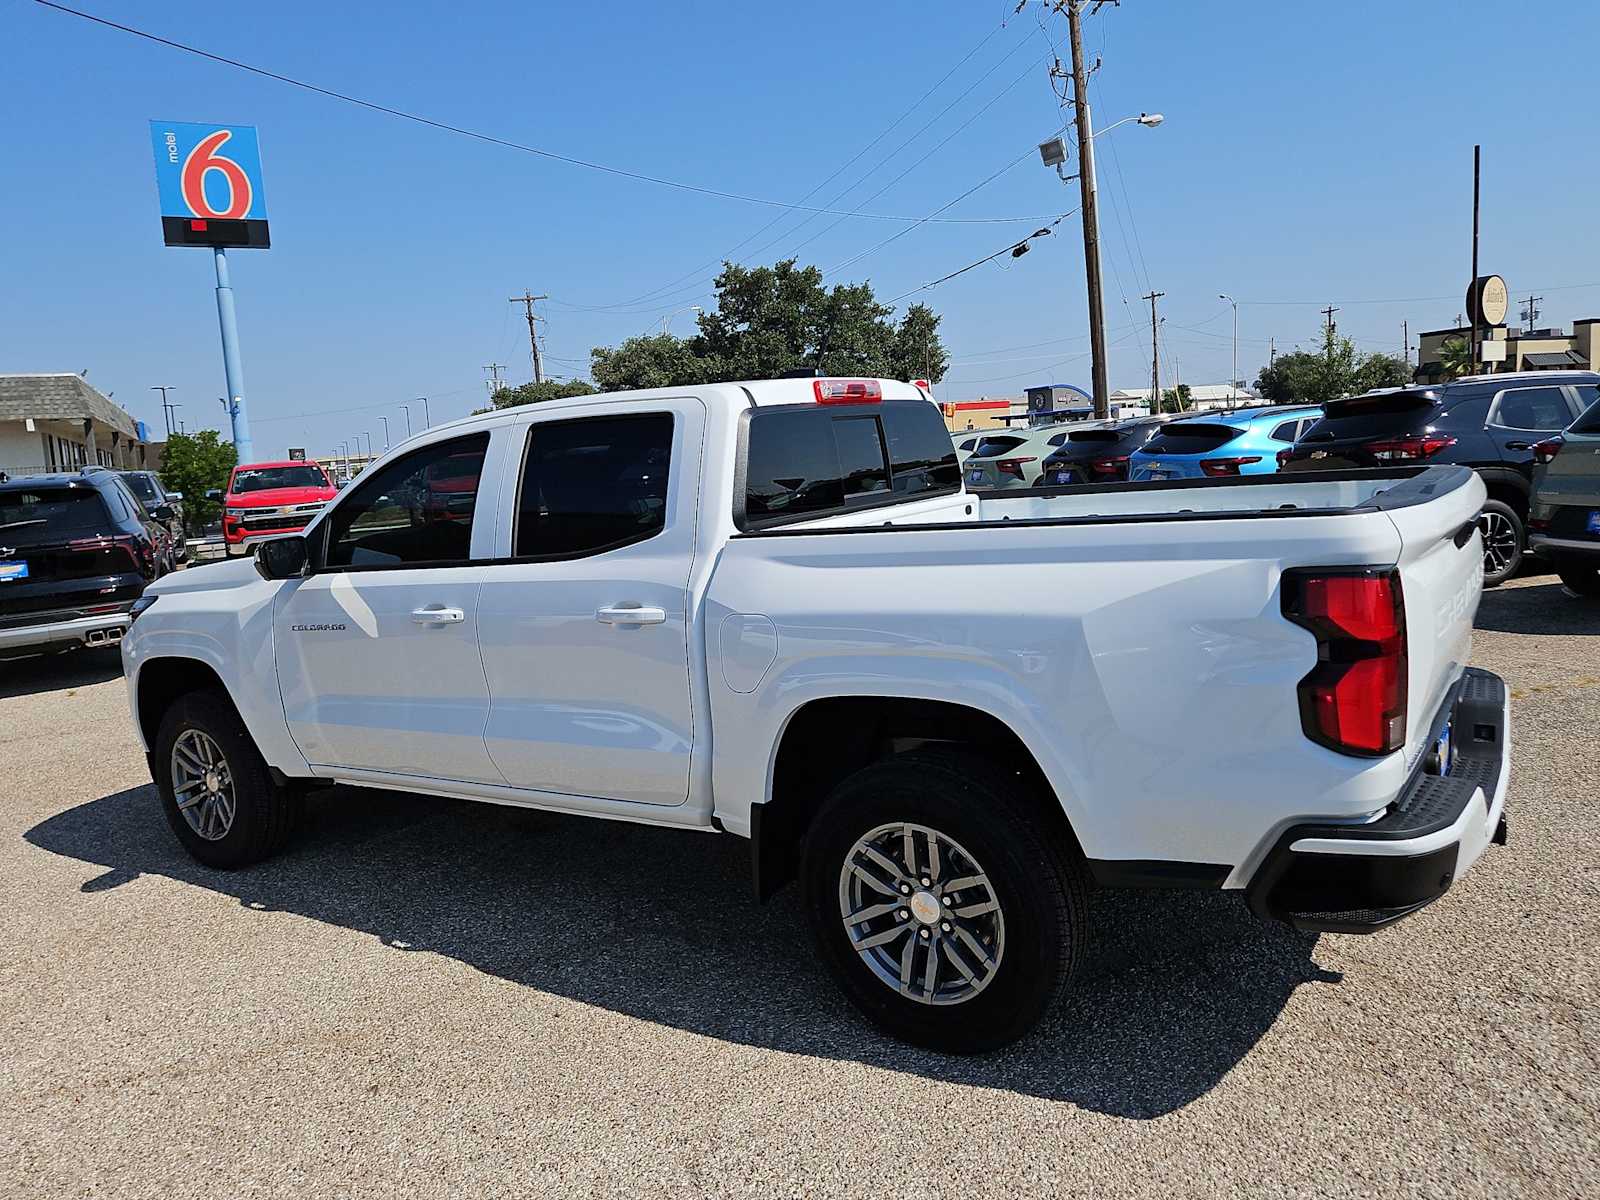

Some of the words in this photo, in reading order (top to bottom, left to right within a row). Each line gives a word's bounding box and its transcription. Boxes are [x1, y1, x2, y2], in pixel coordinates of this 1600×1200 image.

[164, 131, 179, 163] motel
[181, 129, 253, 219] 6
[291, 623, 346, 631] COLORADO
